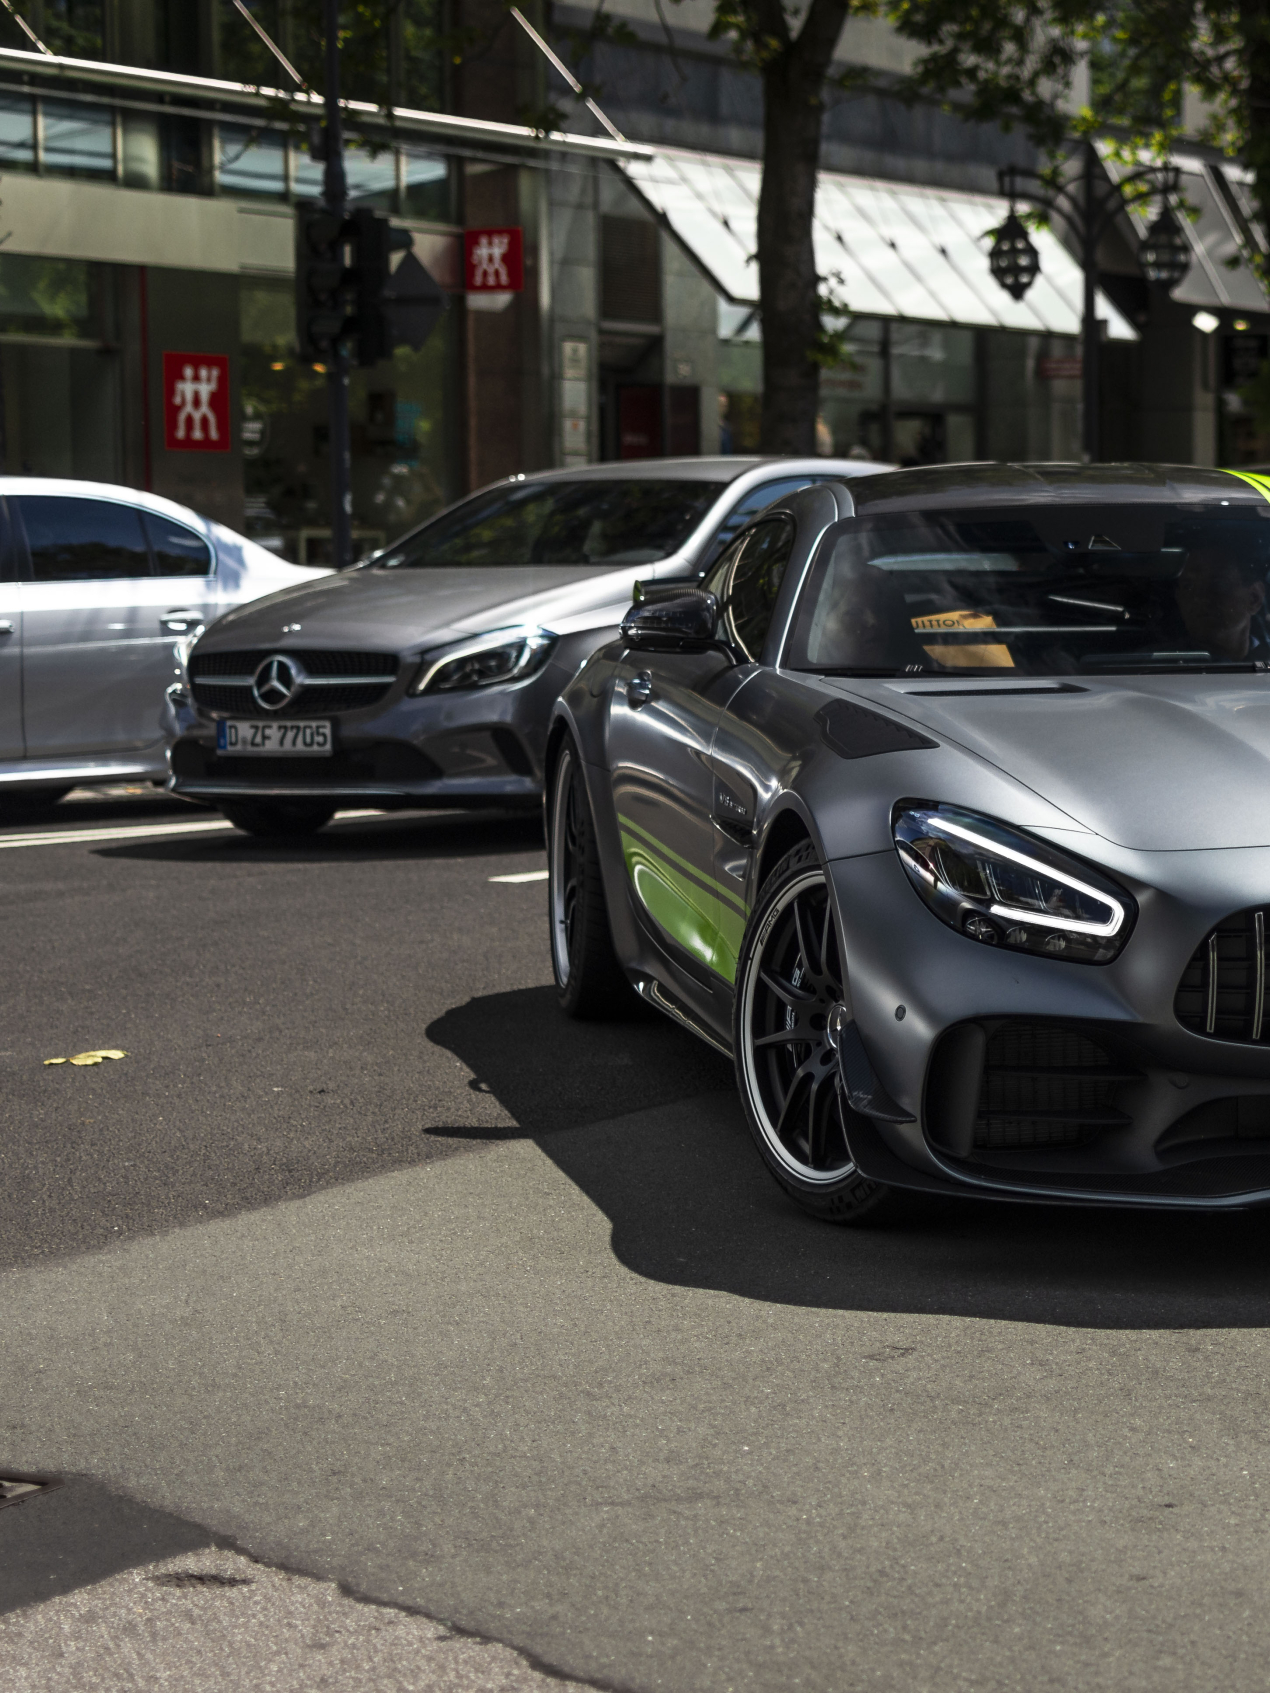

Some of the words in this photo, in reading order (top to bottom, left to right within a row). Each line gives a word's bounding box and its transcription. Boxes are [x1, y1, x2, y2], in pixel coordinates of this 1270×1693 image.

[227, 724, 239, 747] D
[248, 724, 273, 747] ZF
[277, 724, 329, 748] 7705
